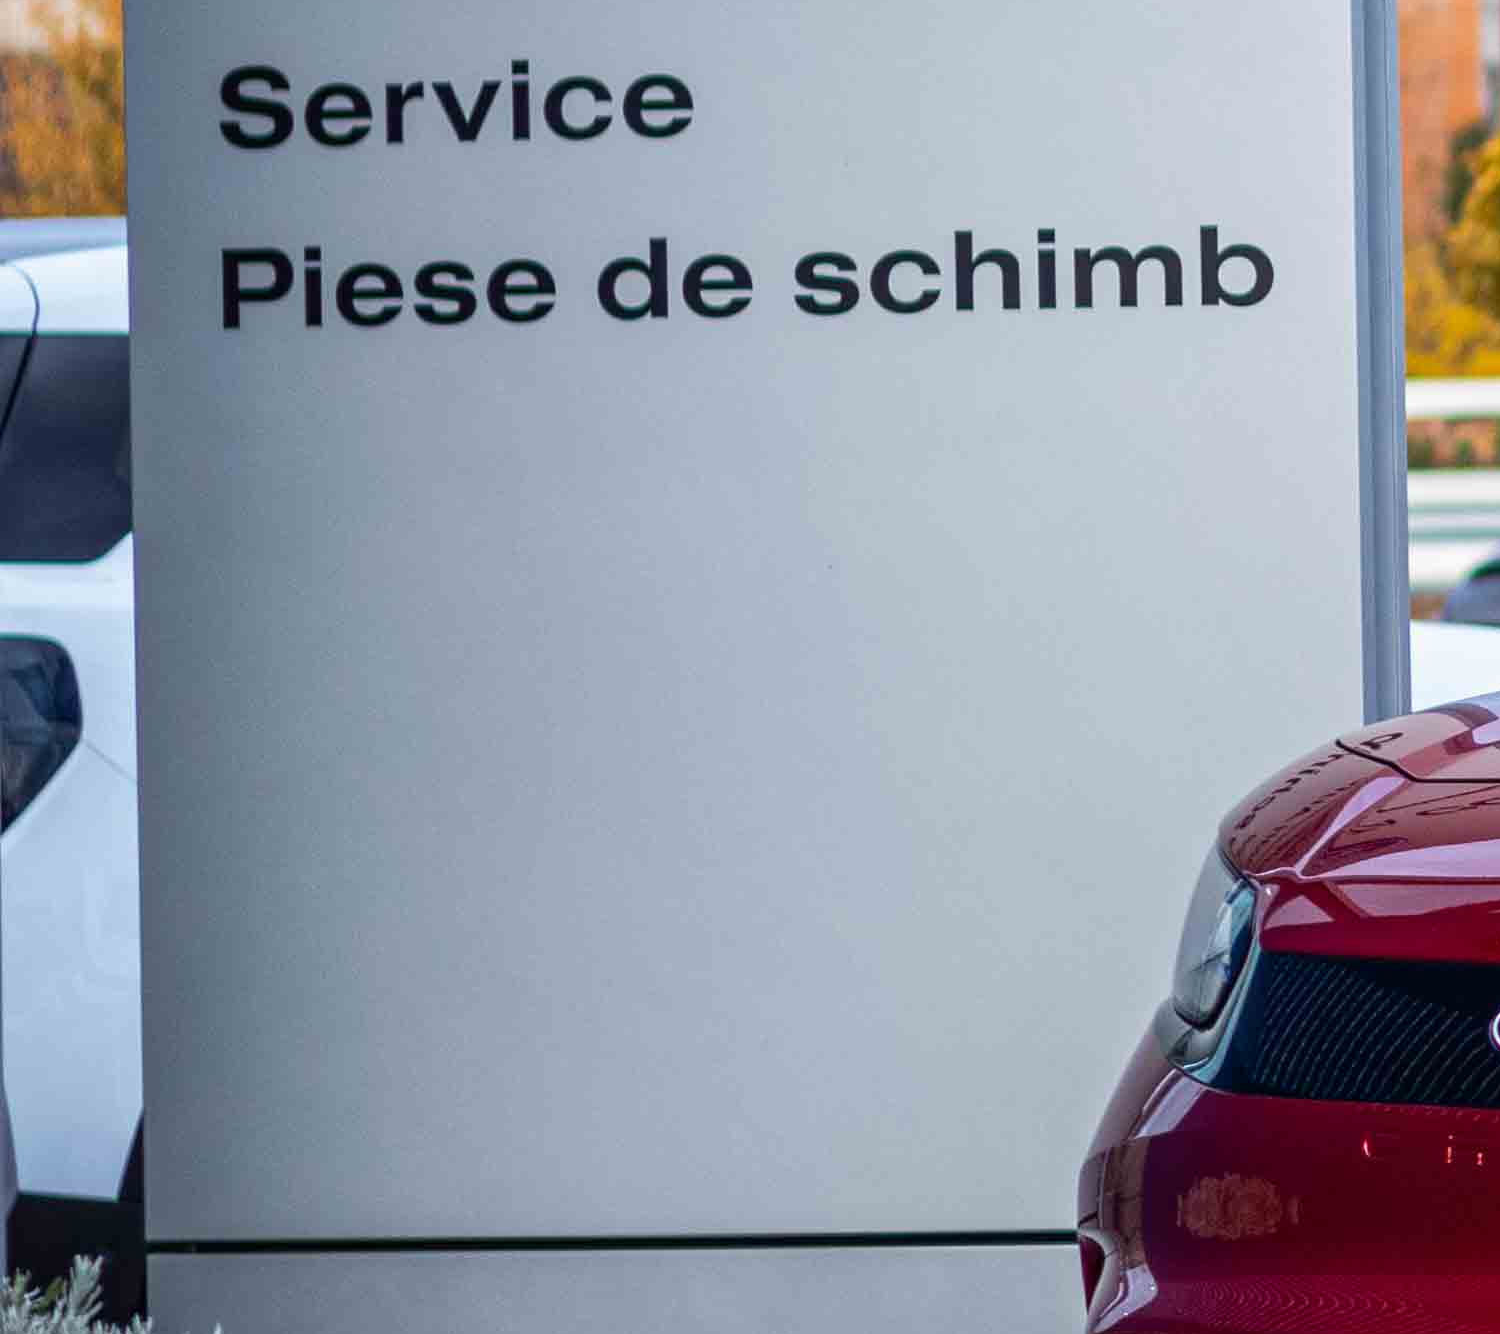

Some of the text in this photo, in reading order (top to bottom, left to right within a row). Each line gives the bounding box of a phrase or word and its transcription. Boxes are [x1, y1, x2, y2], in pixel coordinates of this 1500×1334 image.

[217, 59, 696, 152] Service
[219, 225, 1276, 332] Piese de schimb
